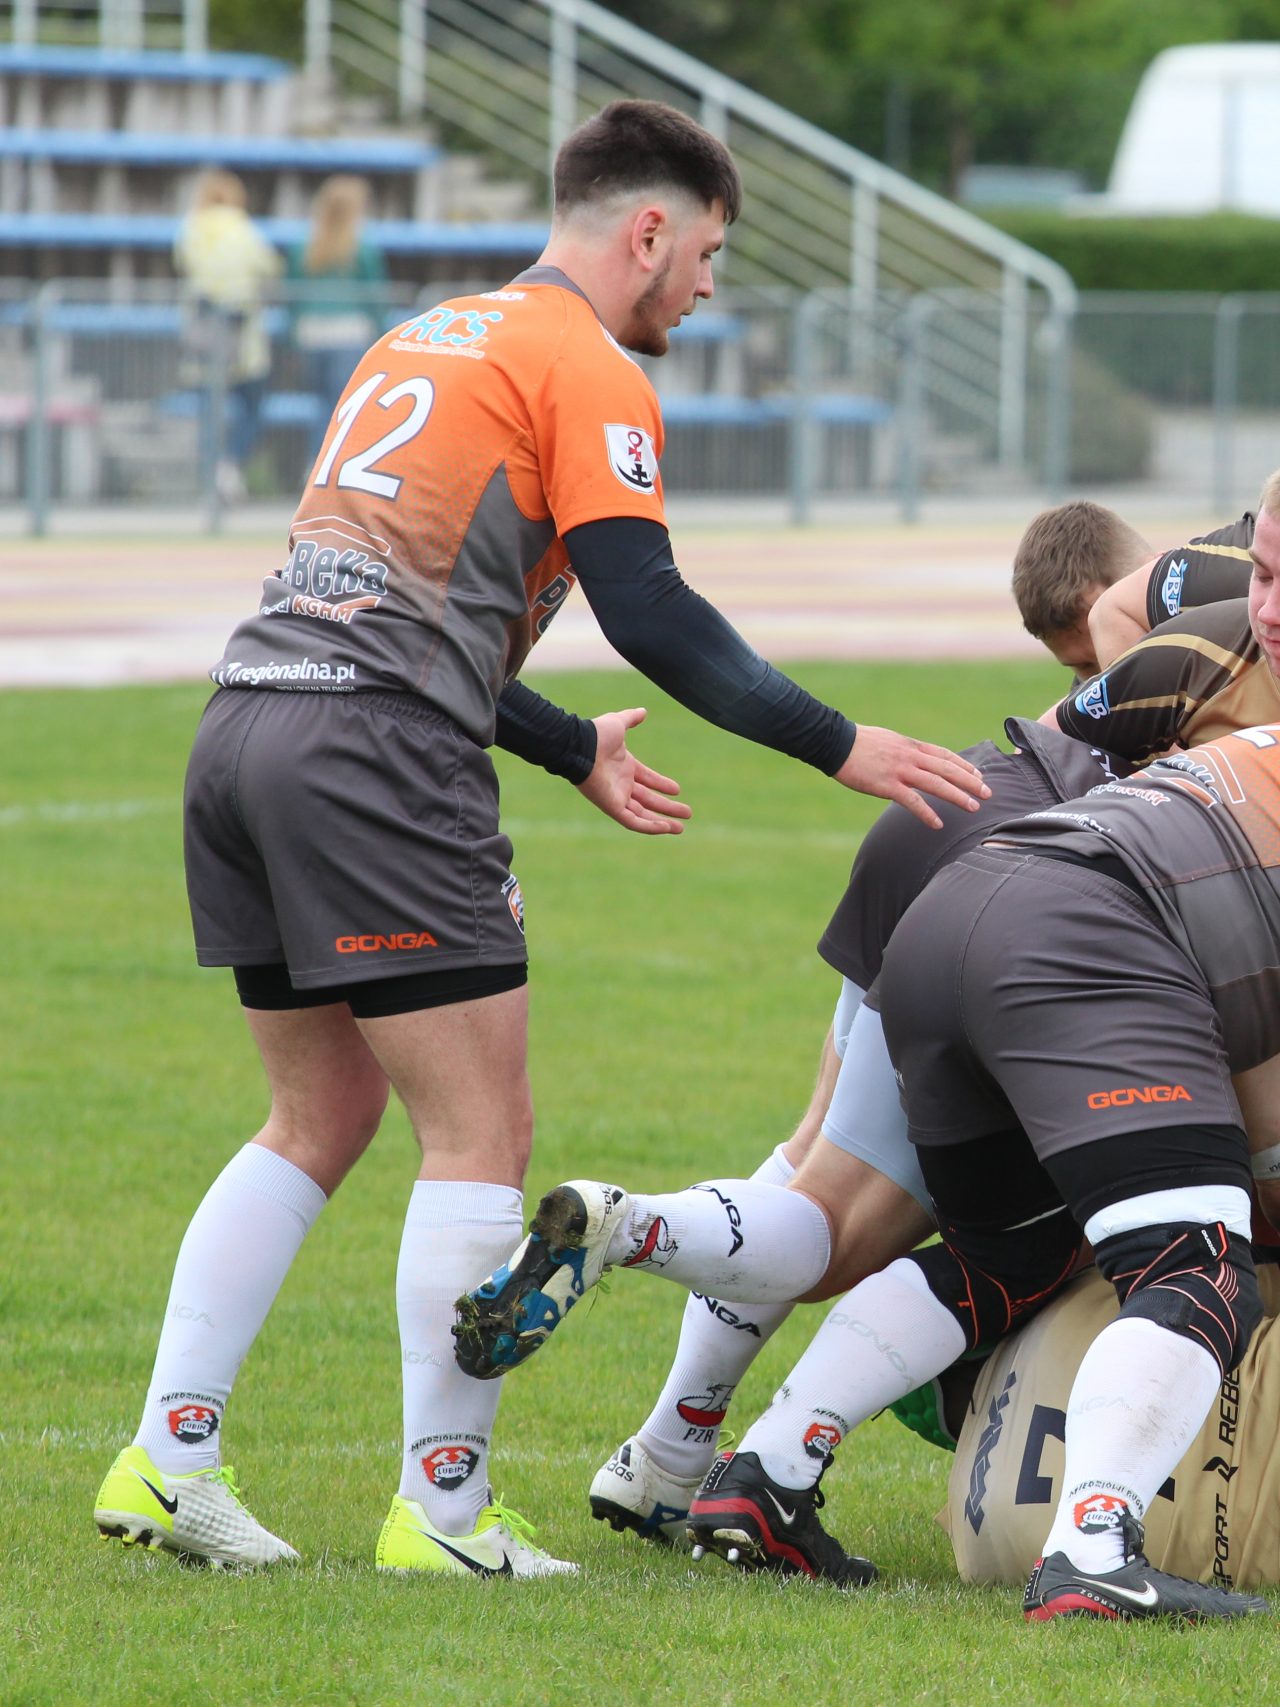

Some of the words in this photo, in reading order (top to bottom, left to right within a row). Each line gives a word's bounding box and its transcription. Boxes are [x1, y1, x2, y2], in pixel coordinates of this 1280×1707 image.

[400, 307, 503, 346] RCS
[313, 371, 435, 502] 12
[292, 594, 356, 624] KGHM
[1218, 1368, 1240, 1447] REBE
[181, 1421, 207, 1430] LUBIN
[683, 1427, 715, 1444] PZR
[437, 1465, 464, 1475] LUBIN
[1086, 1513, 1115, 1523] LUBIN
